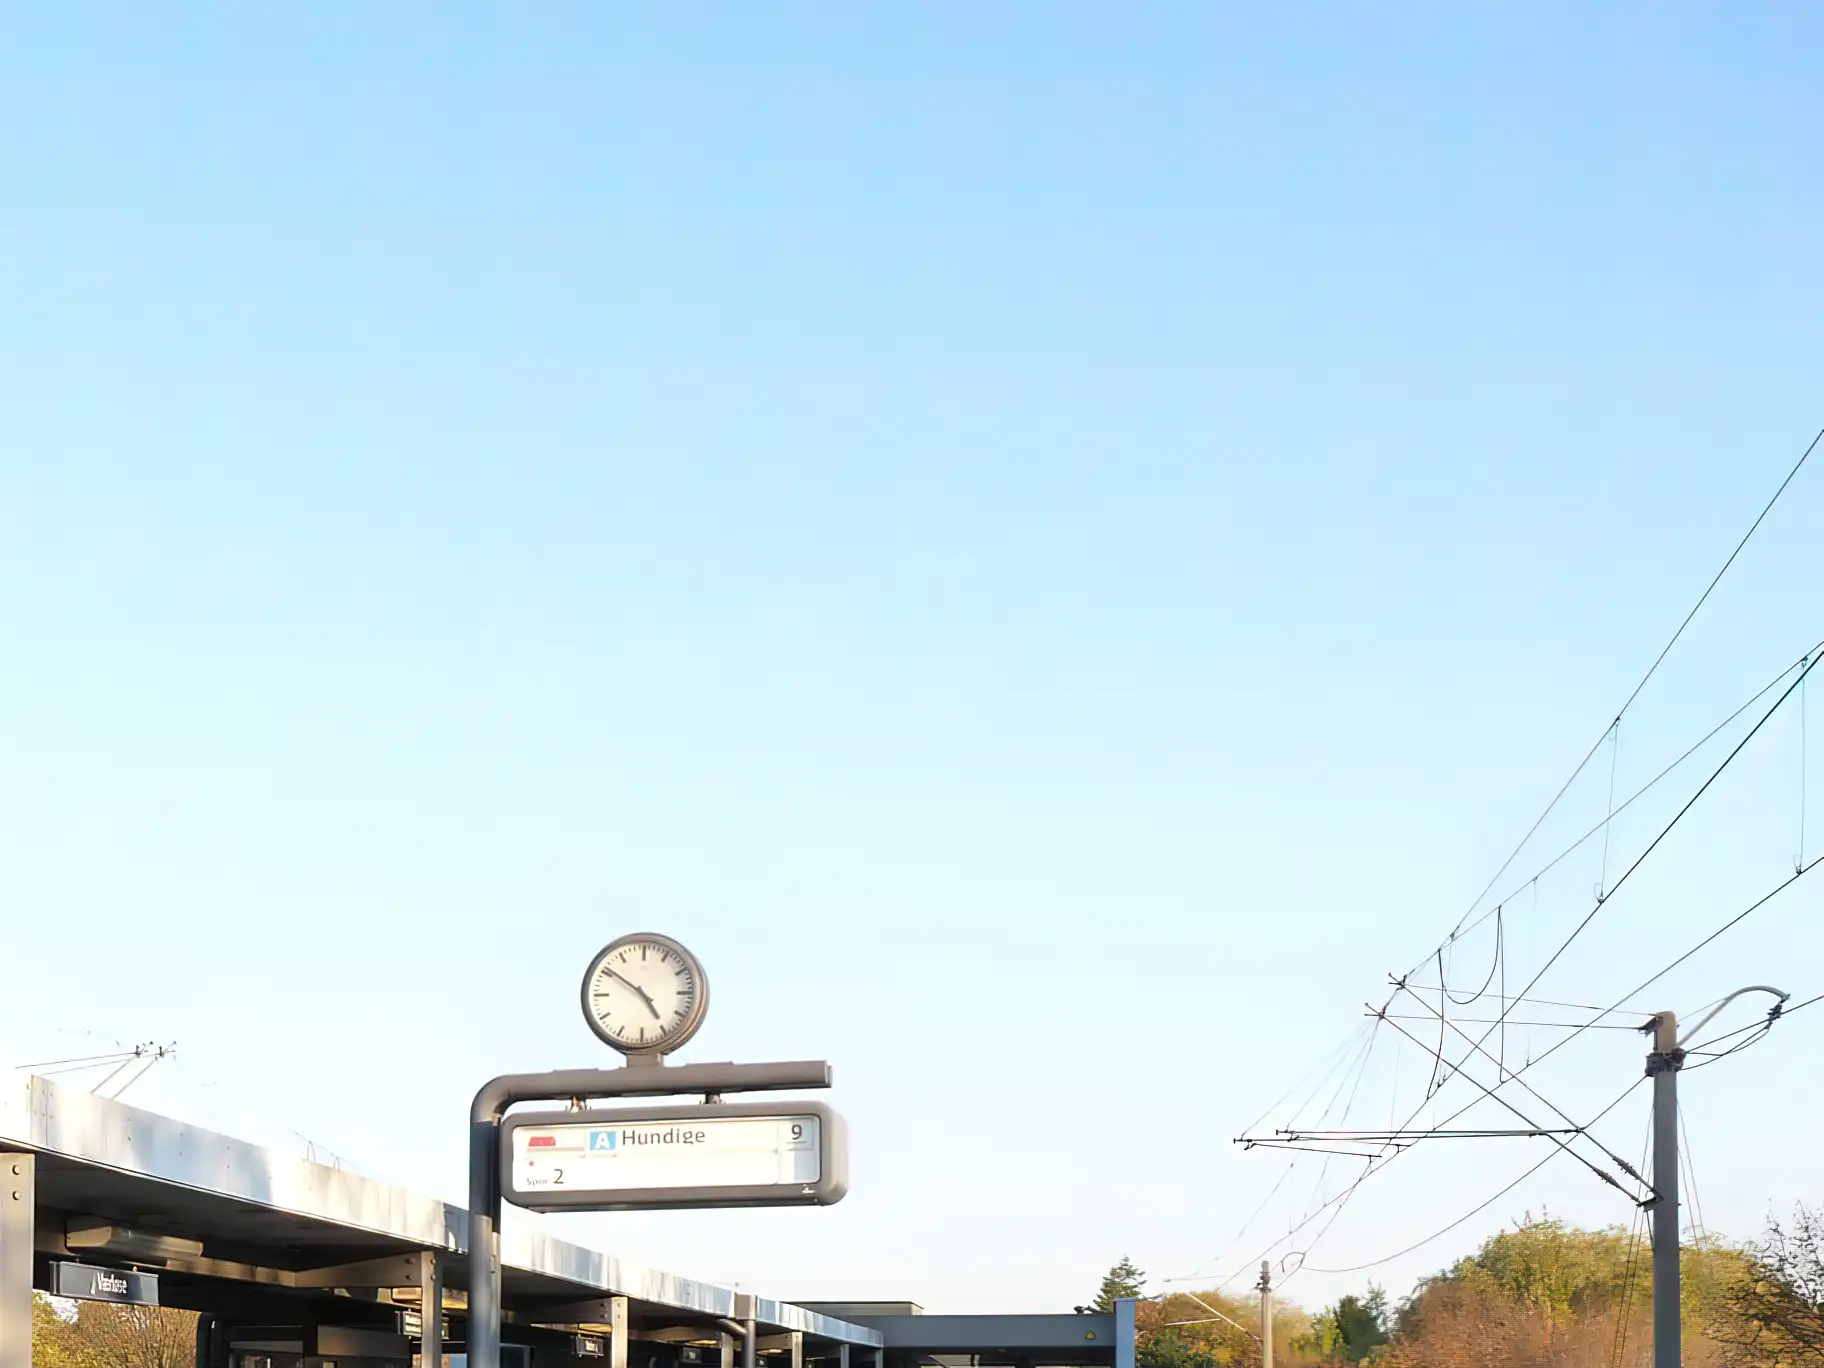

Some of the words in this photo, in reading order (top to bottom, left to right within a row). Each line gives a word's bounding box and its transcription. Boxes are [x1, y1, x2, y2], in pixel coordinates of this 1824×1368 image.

[595, 1132, 612, 1149] A
[622, 1130, 706, 1146] Hundige
[791, 1124, 803, 1140] 9
[553, 1168, 565, 1185] 2
